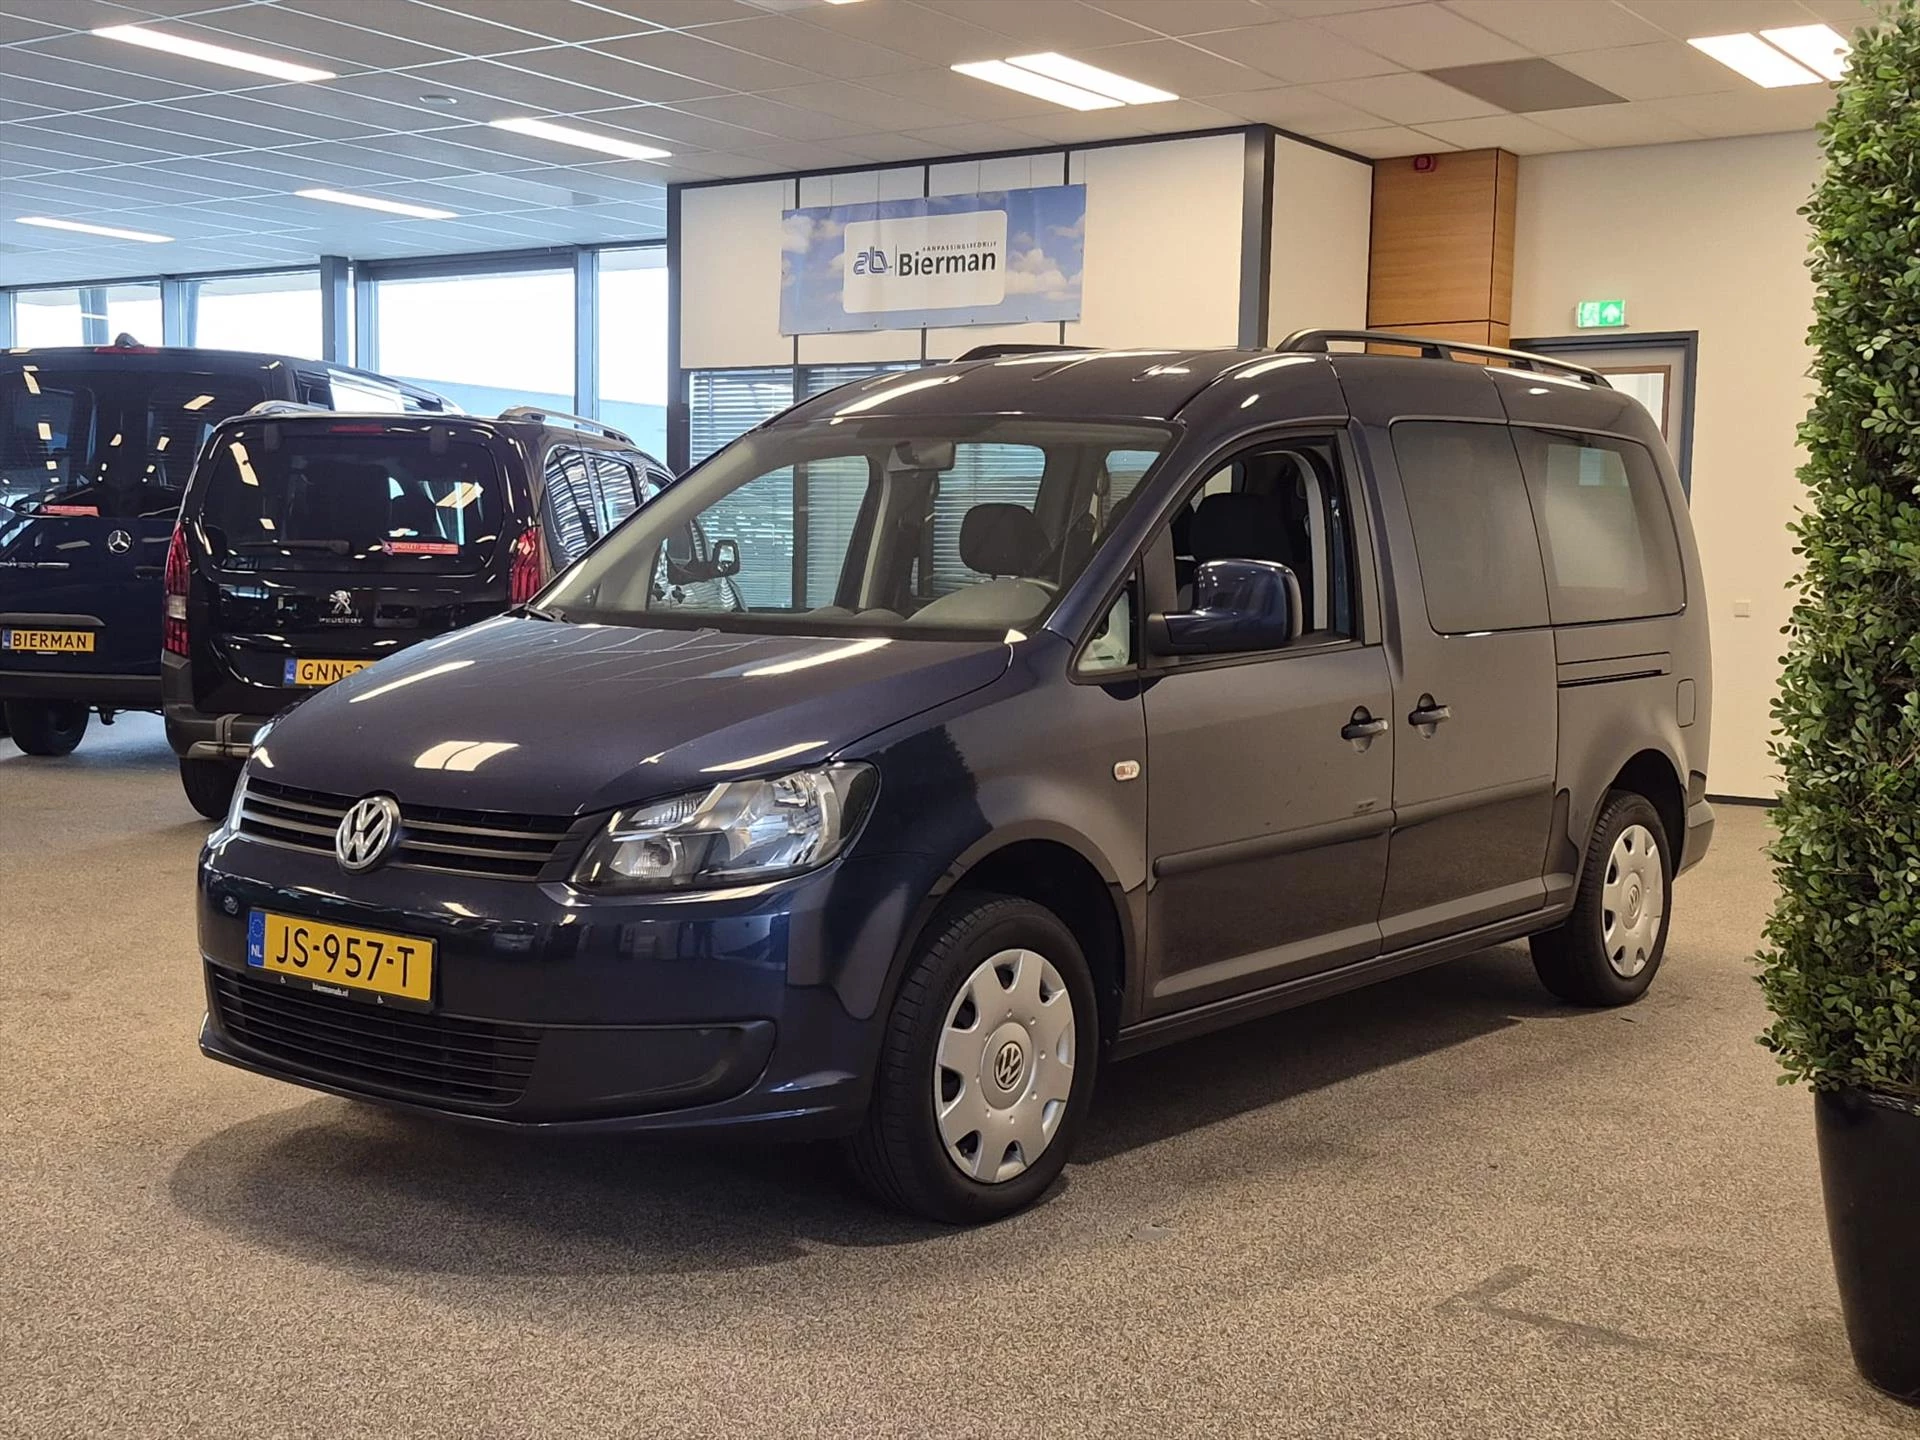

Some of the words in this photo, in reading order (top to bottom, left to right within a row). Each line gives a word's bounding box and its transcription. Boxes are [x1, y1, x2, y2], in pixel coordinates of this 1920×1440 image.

[899, 251, 996, 277] Bierman
[13, 633, 87, 649] BIERMAN
[251, 944, 263, 958] NL
[275, 926, 415, 988] JS-957-T
